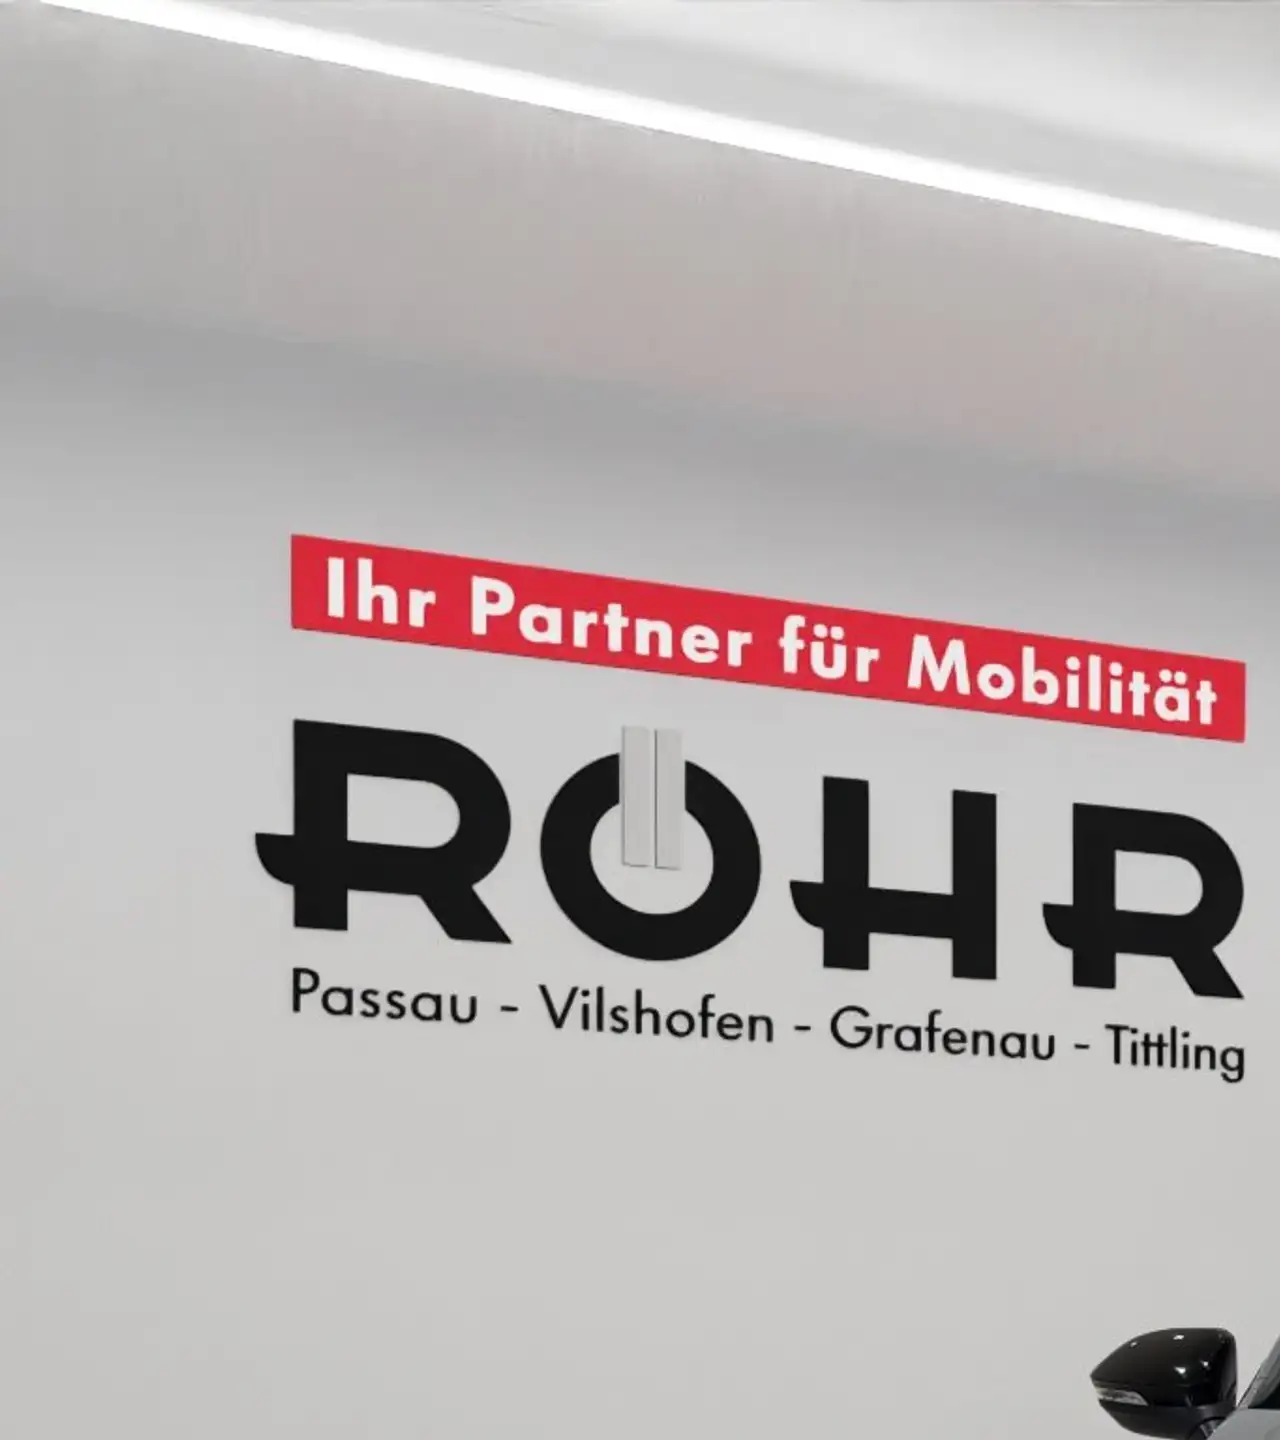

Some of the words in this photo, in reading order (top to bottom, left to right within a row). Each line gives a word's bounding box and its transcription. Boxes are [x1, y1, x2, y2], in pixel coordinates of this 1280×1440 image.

[327, 557, 436, 628] Ihr
[471, 575, 753, 667] Partner
[779, 615, 880, 682] für
[907, 634, 1217, 725] Mobilität
[292, 967, 478, 1024] Passau
[539, 984, 774, 1043] Vilshofen
[830, 1005, 1055, 1061] Grafenau
[1104, 1023, 1245, 1084] Tittling
